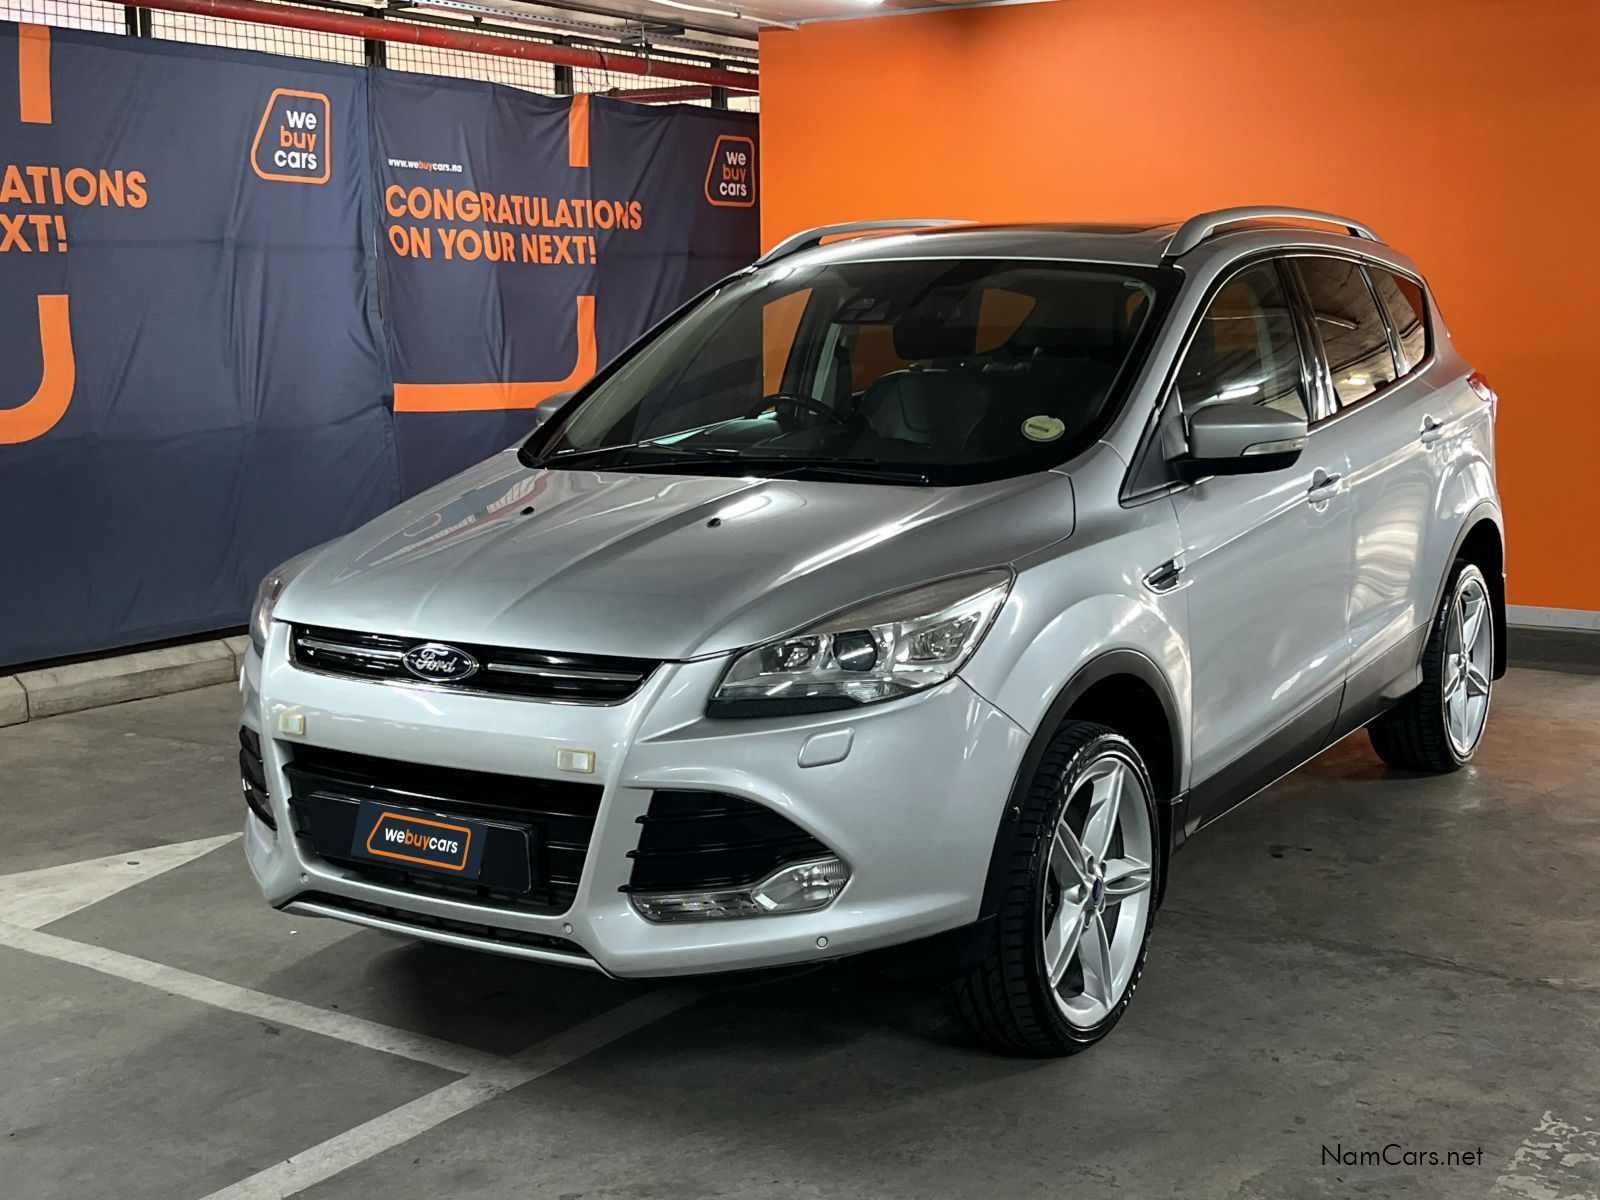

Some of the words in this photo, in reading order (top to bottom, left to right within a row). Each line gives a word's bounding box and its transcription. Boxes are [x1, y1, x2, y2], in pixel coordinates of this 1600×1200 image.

[286, 110, 317, 130] we
[281, 125, 317, 152] buy
[274, 150, 317, 170] cars
[388, 159, 463, 173] www.webuycars.na
[726, 151, 746, 166] we
[723, 163, 746, 184] buy
[0, 165, 148, 208] ATIONS
[719, 182, 747, 197] cars
[385, 184, 643, 231] CONGRATULATIONS
[0, 213, 68, 252] XT!
[388, 225, 432, 258] ON
[437, 228, 516, 262] YOUR
[521, 233, 597, 264] NEXT!
[415, 648, 458, 673] Ford
[385, 828, 459, 854] webuycars
